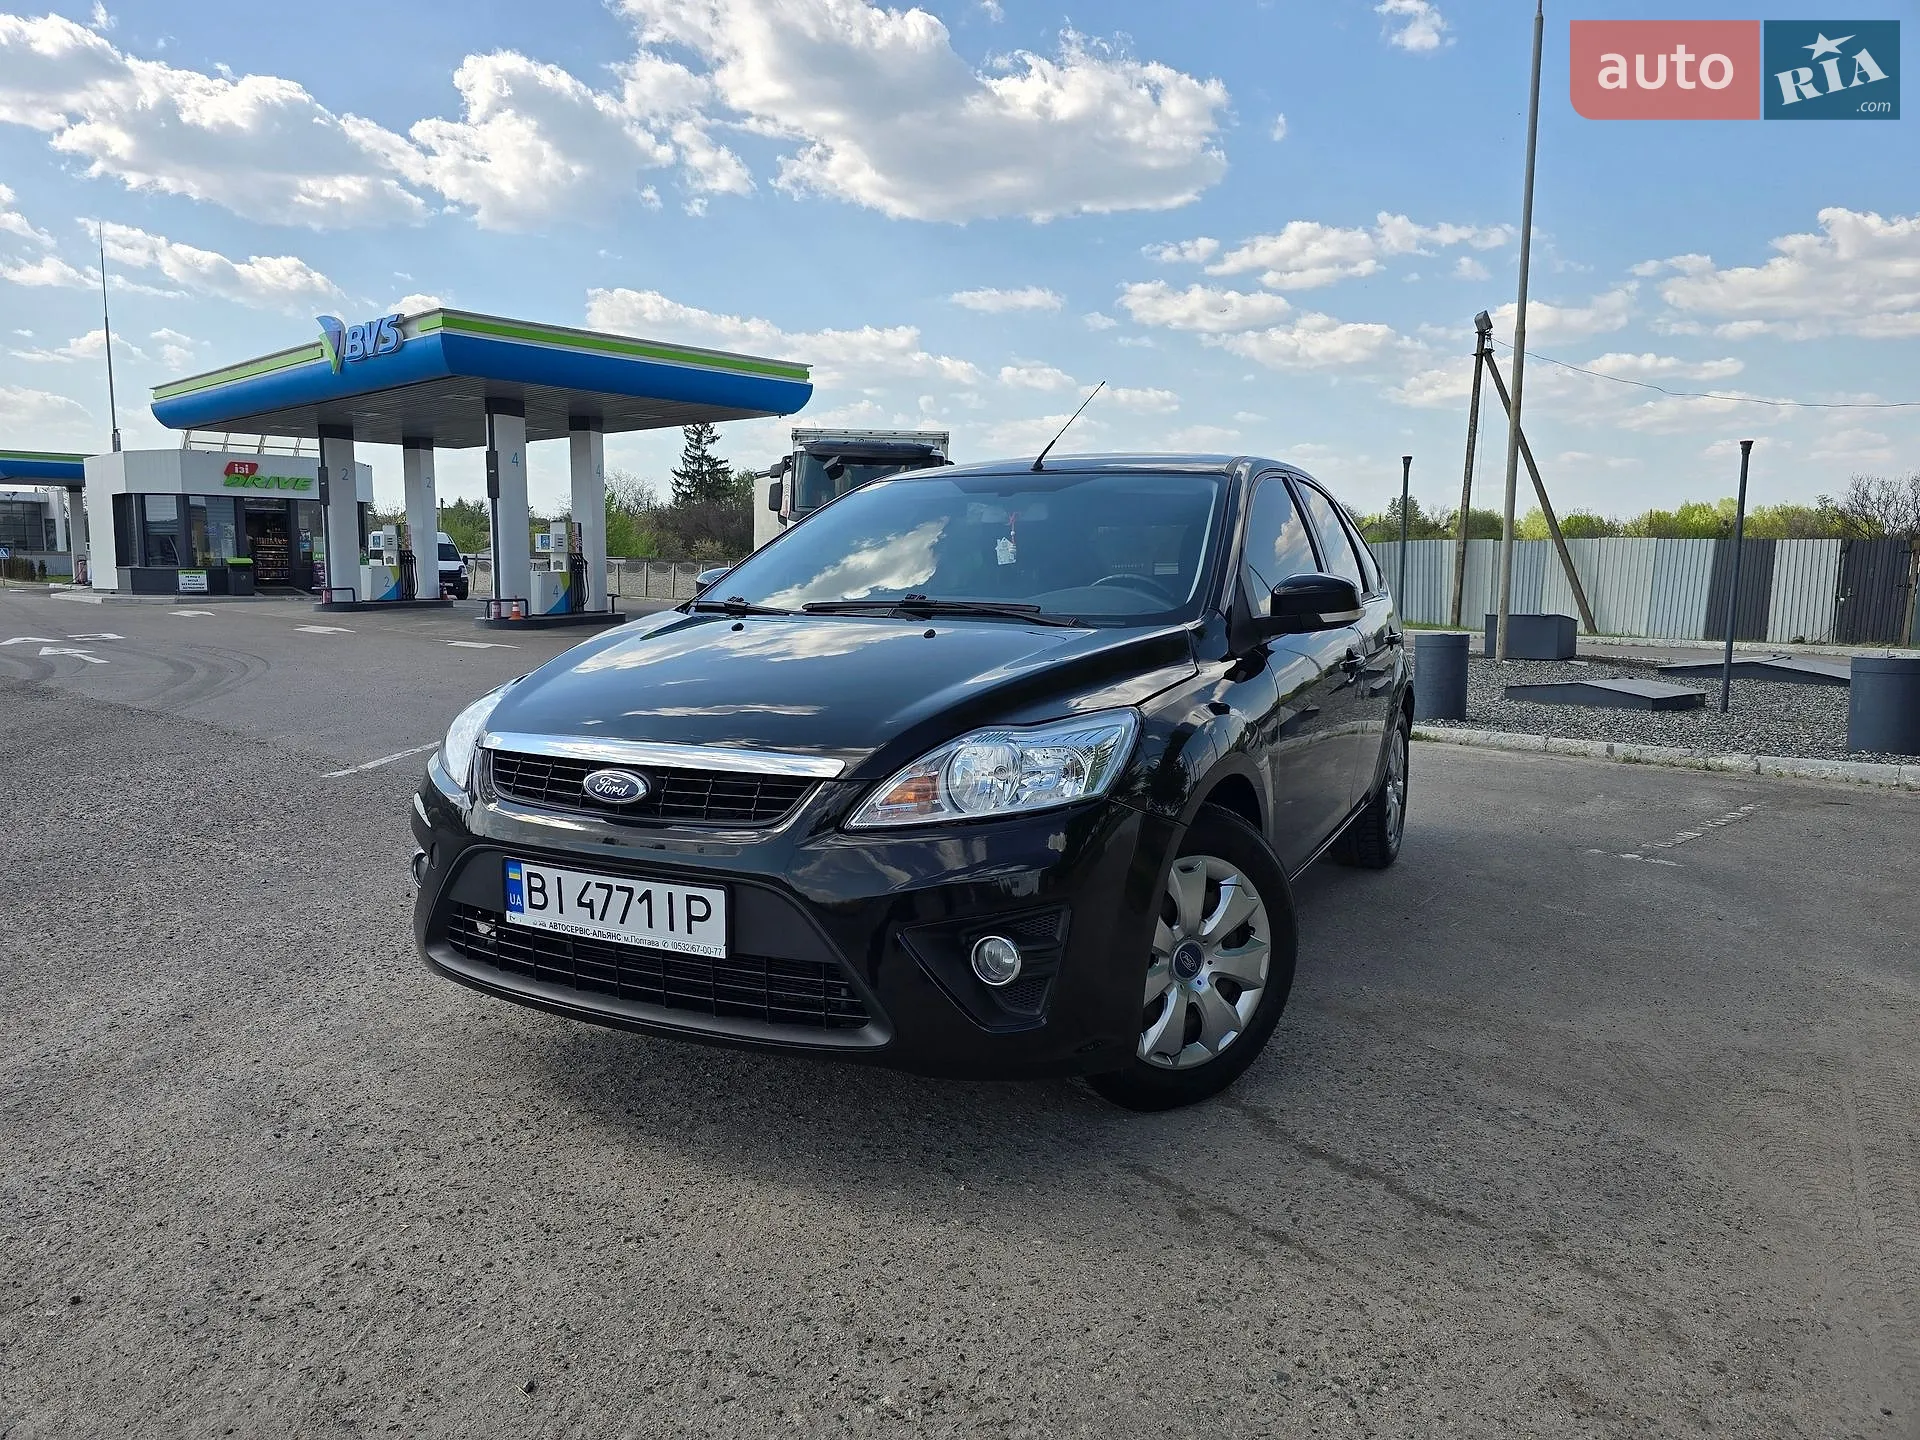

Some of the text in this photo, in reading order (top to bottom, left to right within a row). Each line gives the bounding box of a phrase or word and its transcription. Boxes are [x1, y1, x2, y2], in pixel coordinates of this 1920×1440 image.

[344, 314, 404, 362] BVS
[511, 453, 520, 467] 4
[223, 473, 314, 491] DRIVE
[342, 468, 350, 481] 2
[384, 576, 391, 587] 2
[552, 585, 559, 597] 4
[595, 776, 629, 796] Ford
[509, 892, 523, 907] UA
[526, 871, 712, 935] BI 4771 IP
